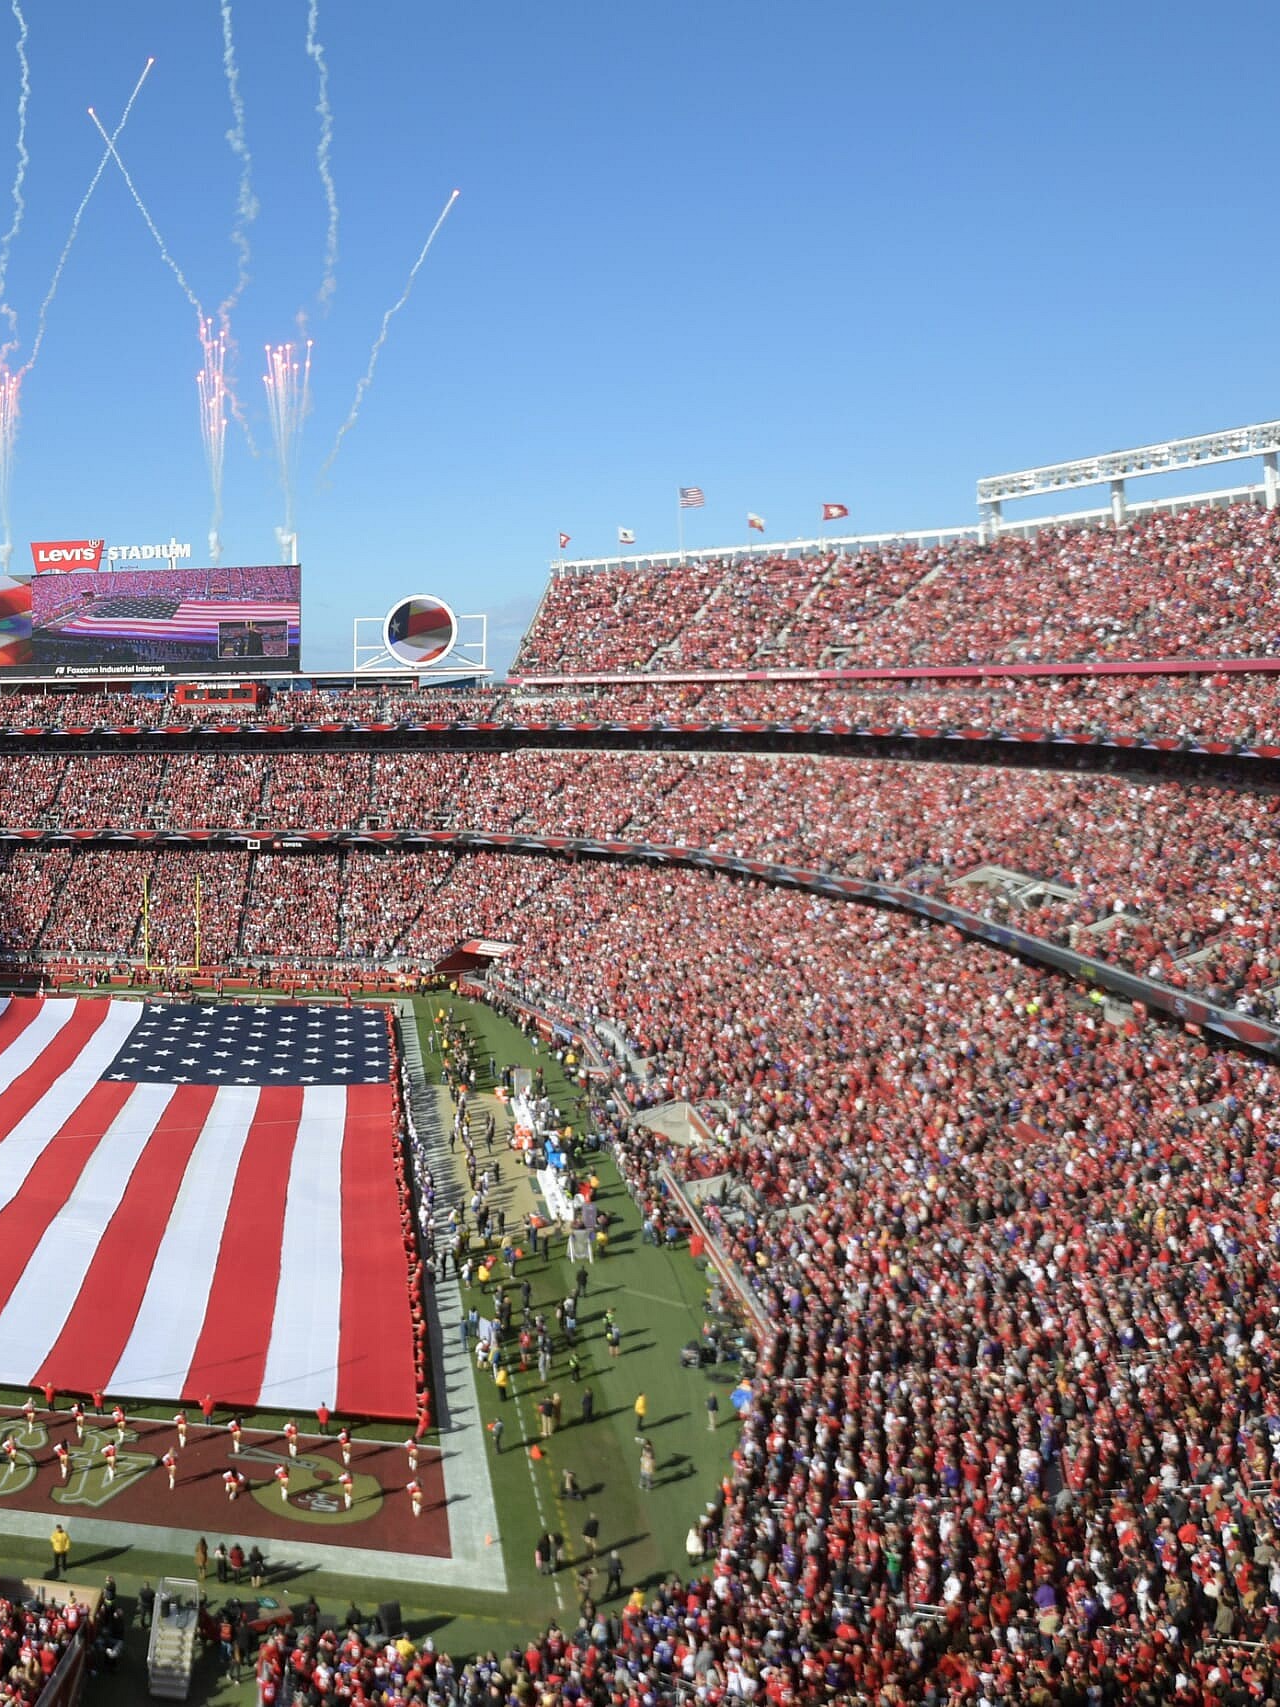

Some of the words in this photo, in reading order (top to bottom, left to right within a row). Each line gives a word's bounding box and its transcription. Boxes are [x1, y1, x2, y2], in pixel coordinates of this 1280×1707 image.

[107, 543, 191, 561] STADIUM
[67, 666, 99, 674] Foxconn
[99, 665, 135, 673] Industrial
[136, 664, 165, 672] Internet
